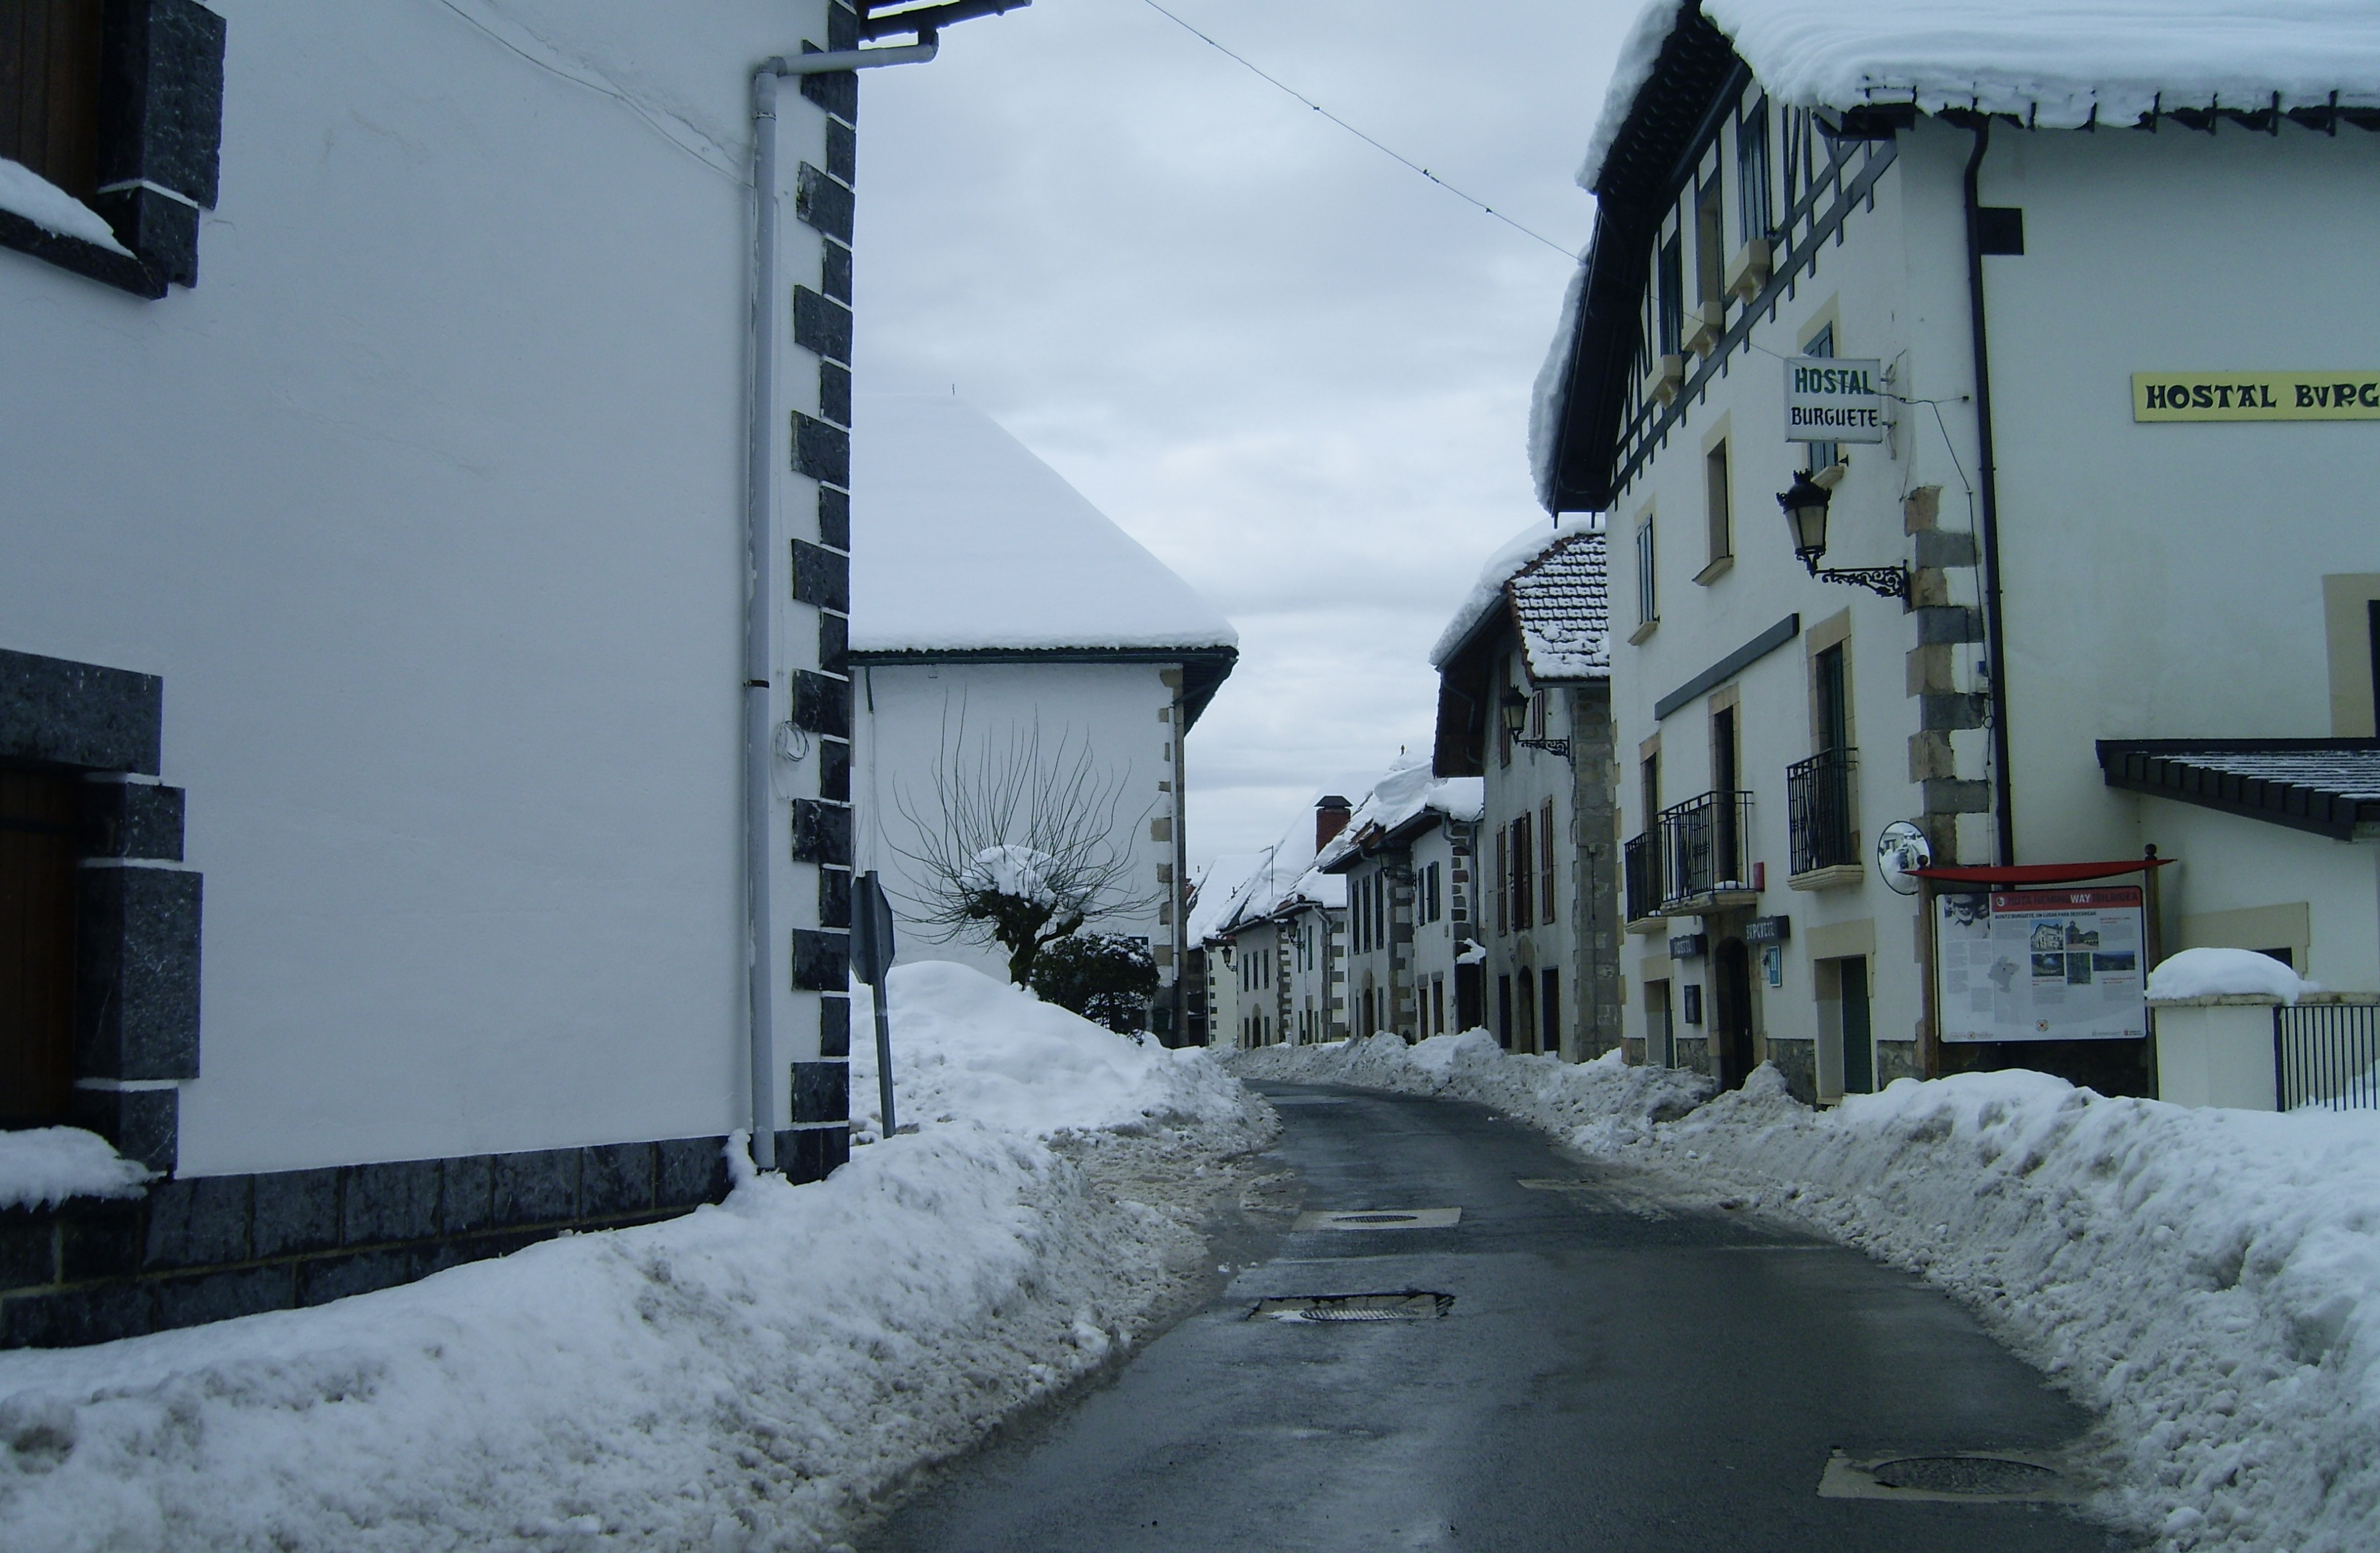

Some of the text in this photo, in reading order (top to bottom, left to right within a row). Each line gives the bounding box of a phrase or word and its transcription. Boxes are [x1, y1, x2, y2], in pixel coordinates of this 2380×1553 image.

[1795, 368, 1875, 395] HOSTAL
[2146, 384, 2277, 409] HOSTAL
[1791, 407, 1878, 427] BURGUETE
